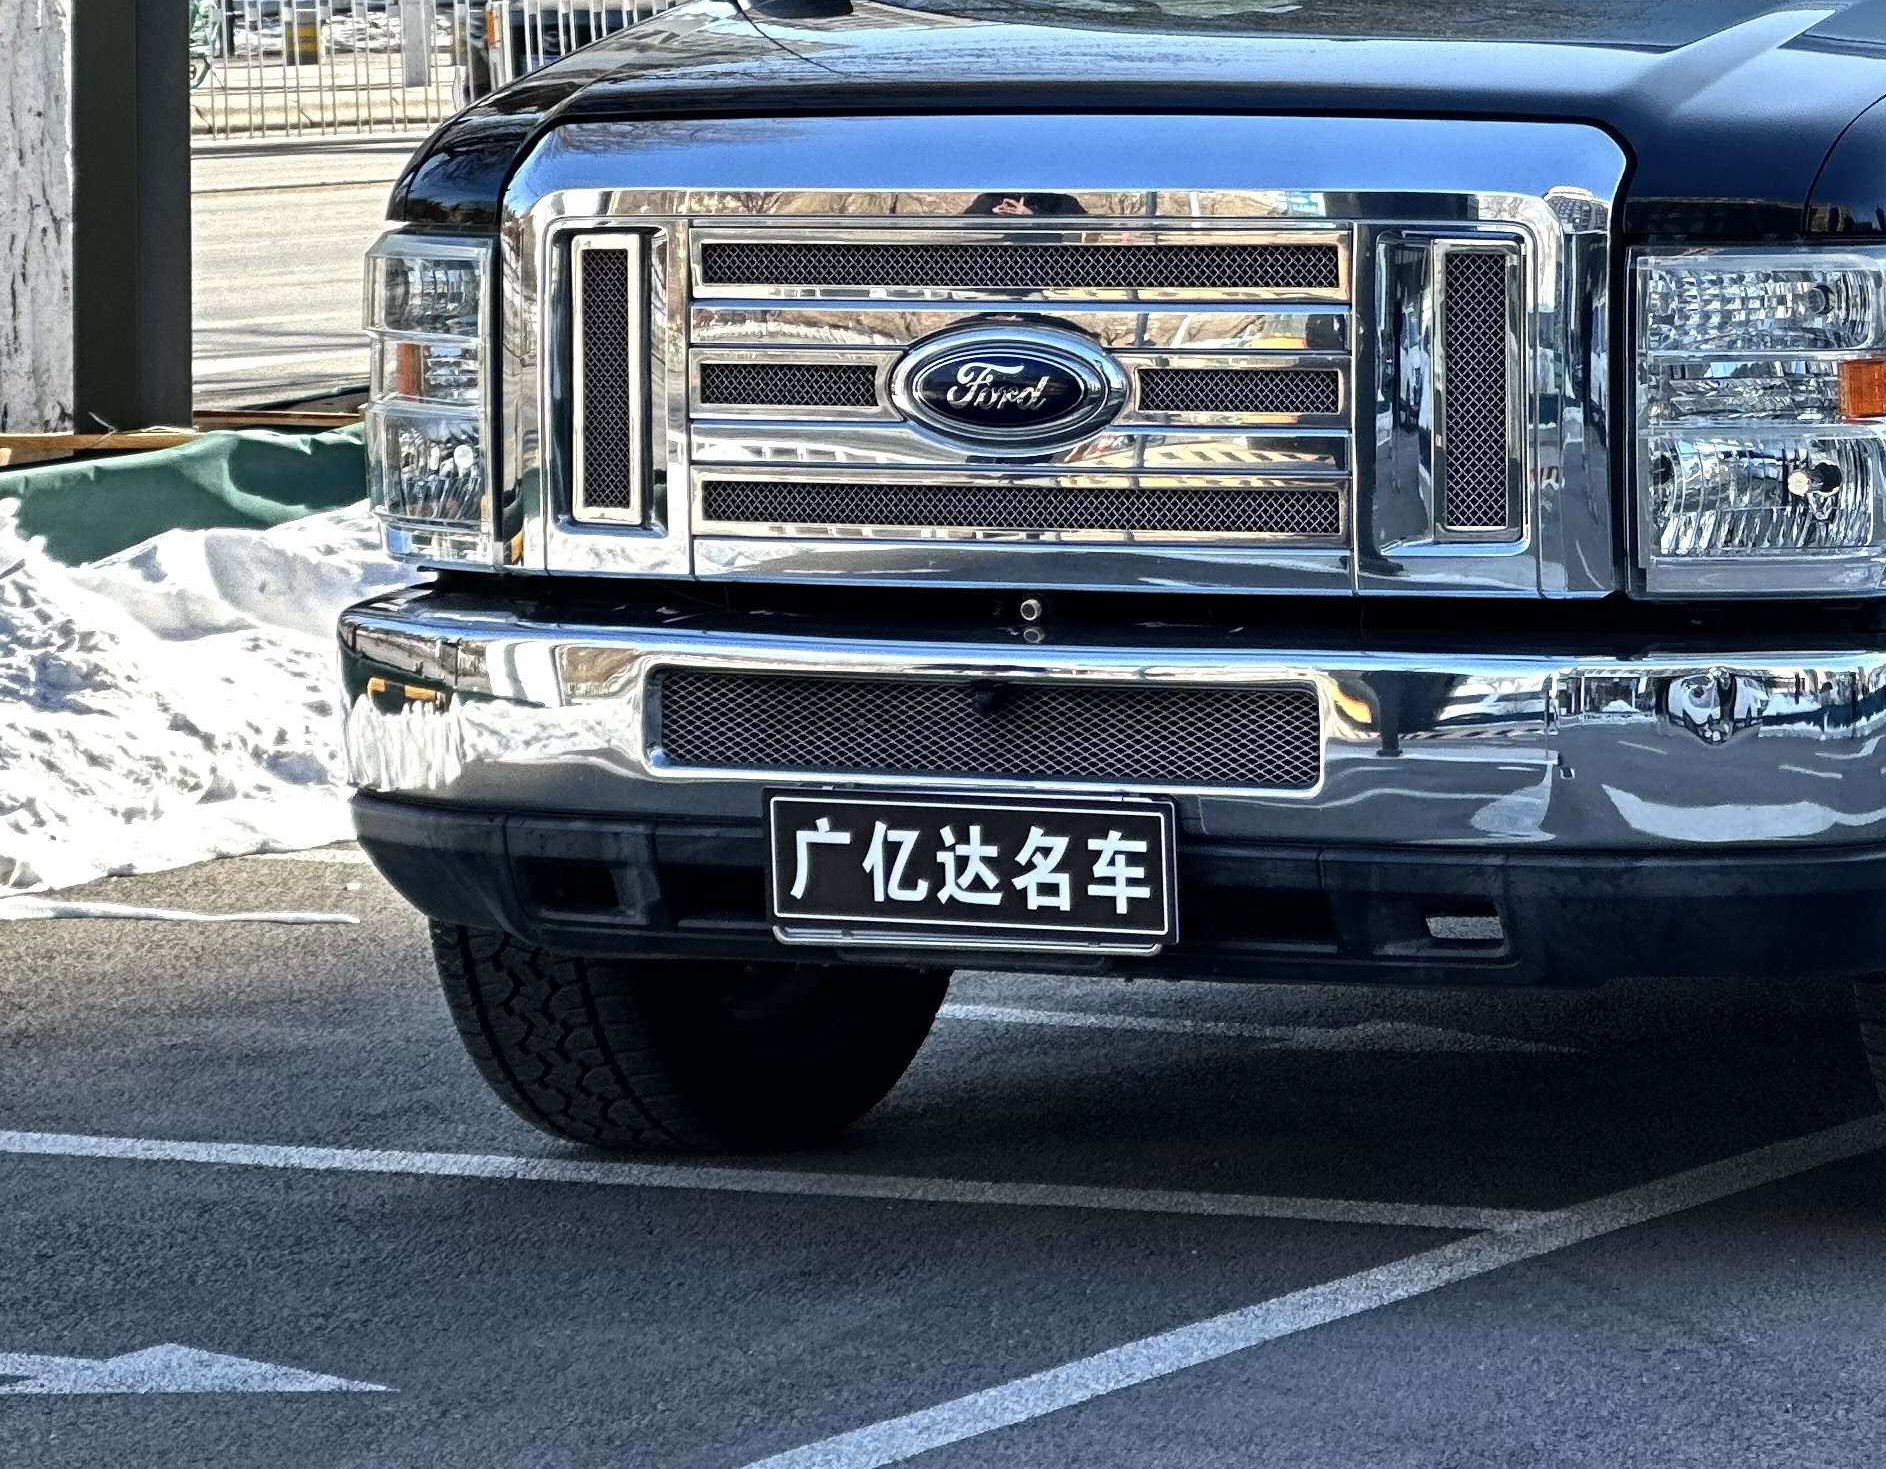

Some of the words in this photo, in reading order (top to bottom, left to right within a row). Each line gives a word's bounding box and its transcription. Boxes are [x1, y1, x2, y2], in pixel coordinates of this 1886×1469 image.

[946, 362, 1050, 411] Ford
[790, 817, 1151, 915] 广亿达名车
